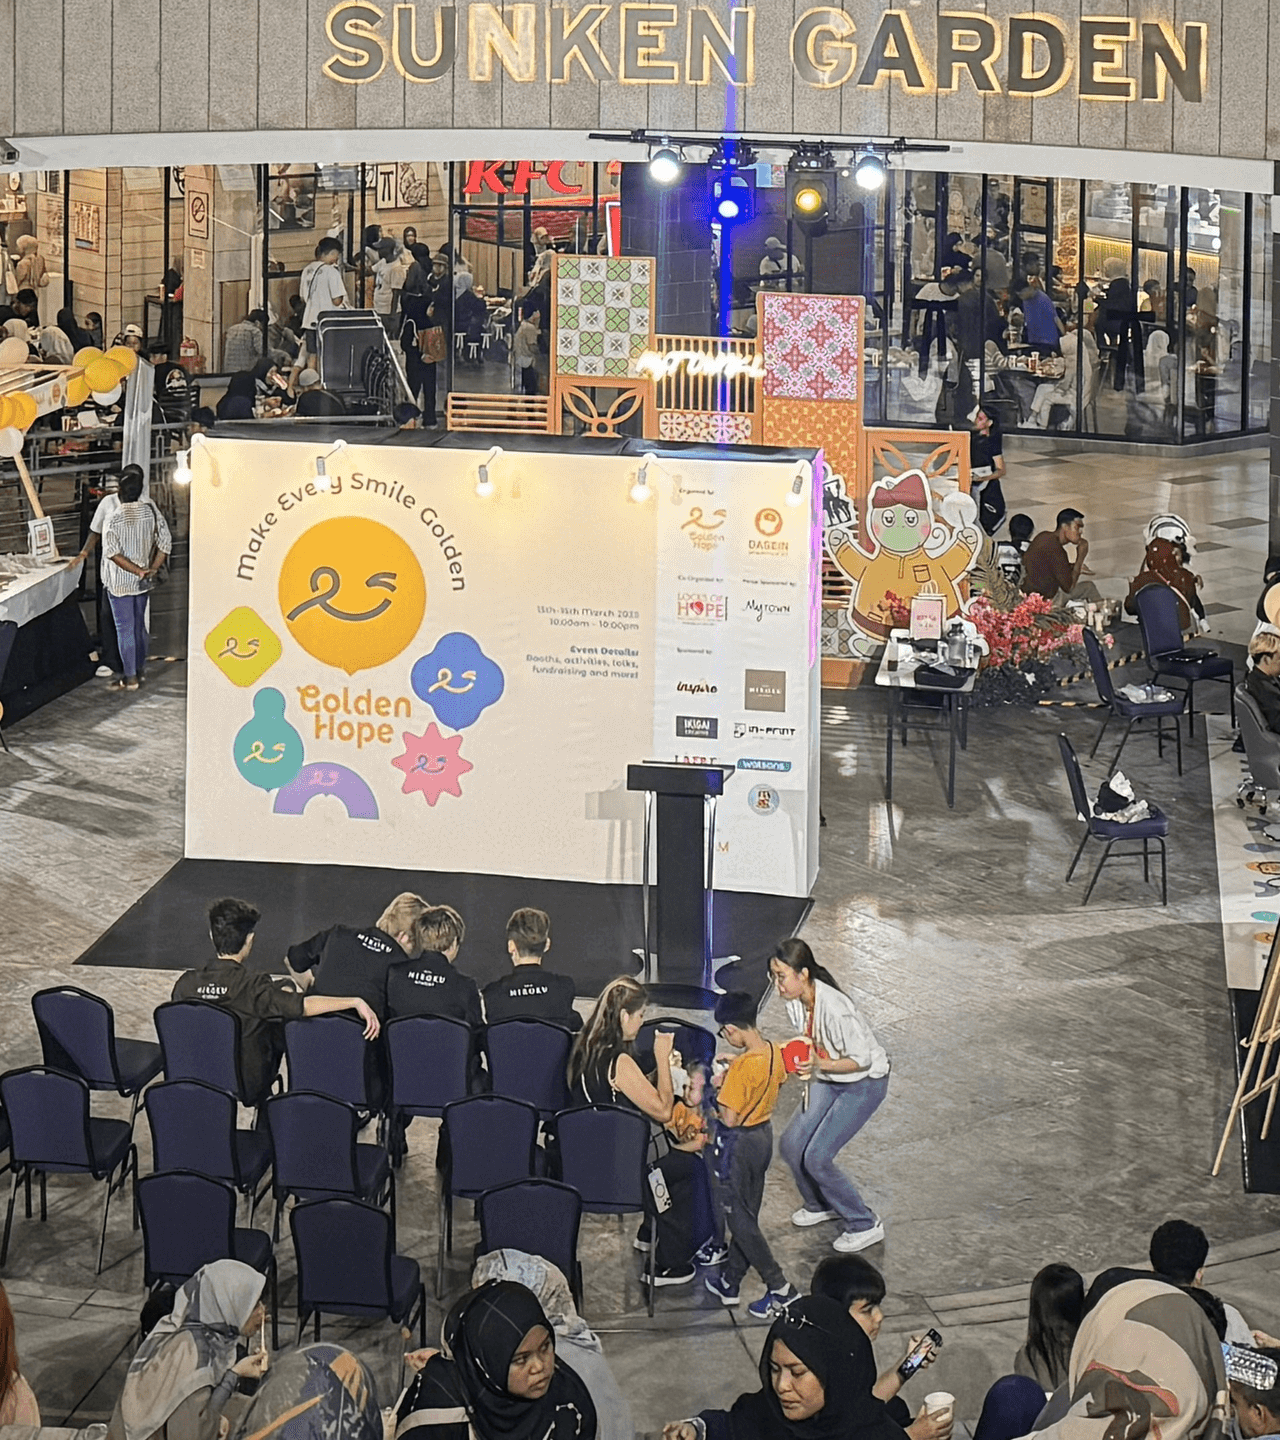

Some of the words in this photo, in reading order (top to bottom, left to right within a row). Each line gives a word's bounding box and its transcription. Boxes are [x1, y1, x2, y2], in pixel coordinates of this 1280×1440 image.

[789, 6, 1209, 104] GARDEN
[462, 160, 583, 194] KFC
[277, 475, 343, 511] Evey
[350, 472, 417, 509] Smile
[419, 507, 466, 592] Golden
[570, 645, 598, 656] Event
[589, 667, 609, 678] and
[296, 684, 412, 719] Golden
[314, 712, 395, 749] Hope
